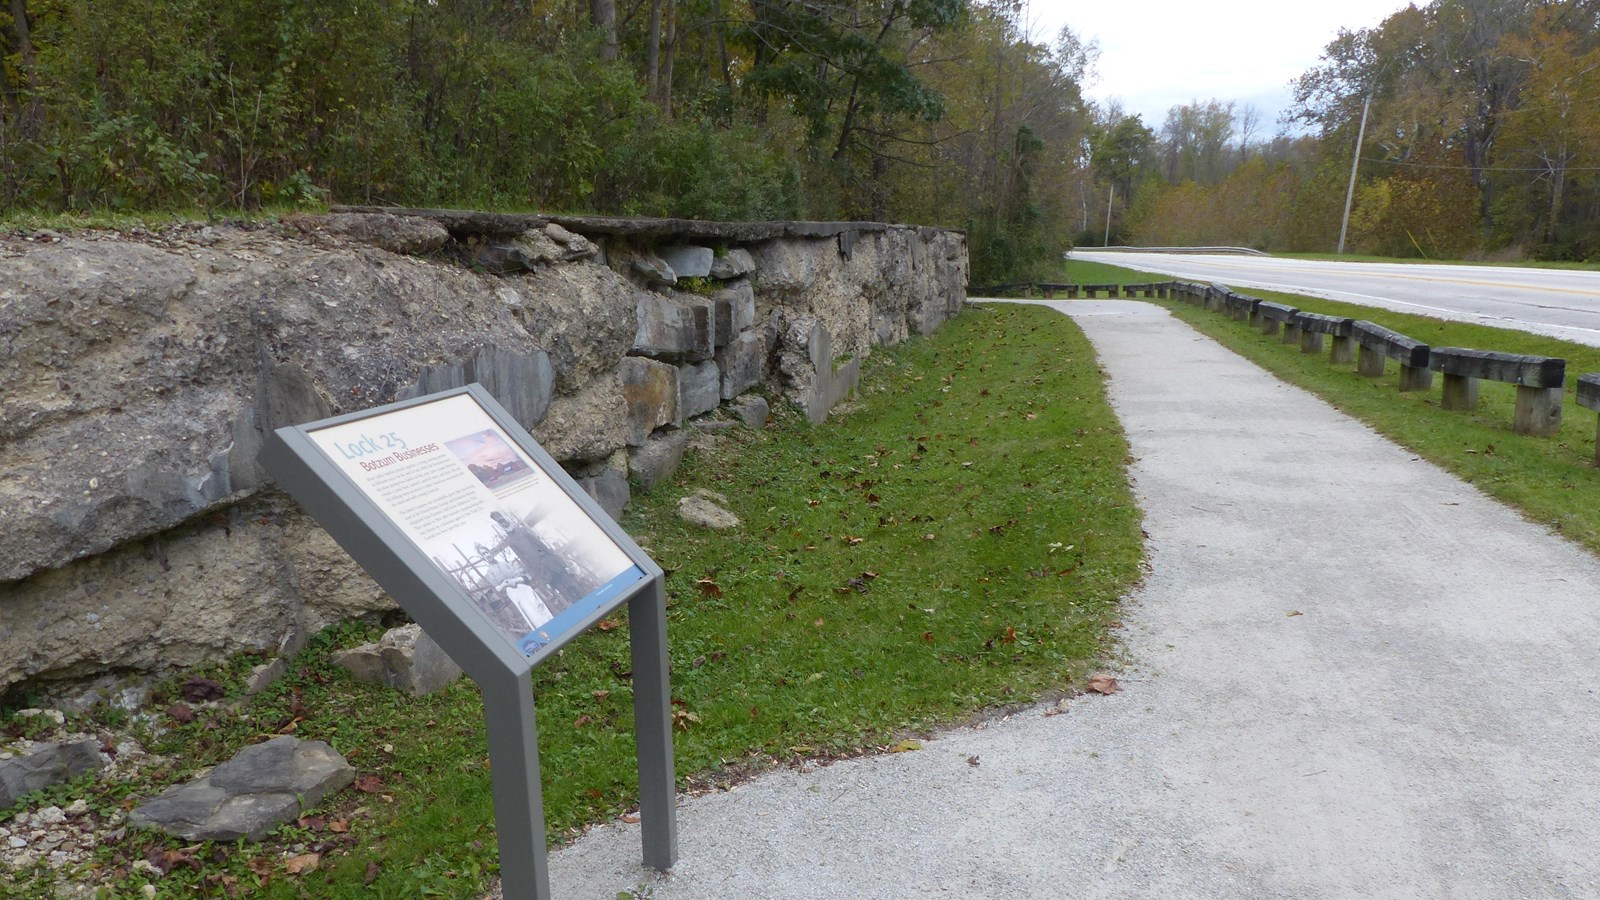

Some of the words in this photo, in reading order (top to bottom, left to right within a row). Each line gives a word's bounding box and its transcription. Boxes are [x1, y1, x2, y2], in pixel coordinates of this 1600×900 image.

[334, 434, 383, 460] Lock
[379, 432, 407, 449] 25
[360, 456, 396, 472] Botzum
[393, 443, 440, 461] Businesses
